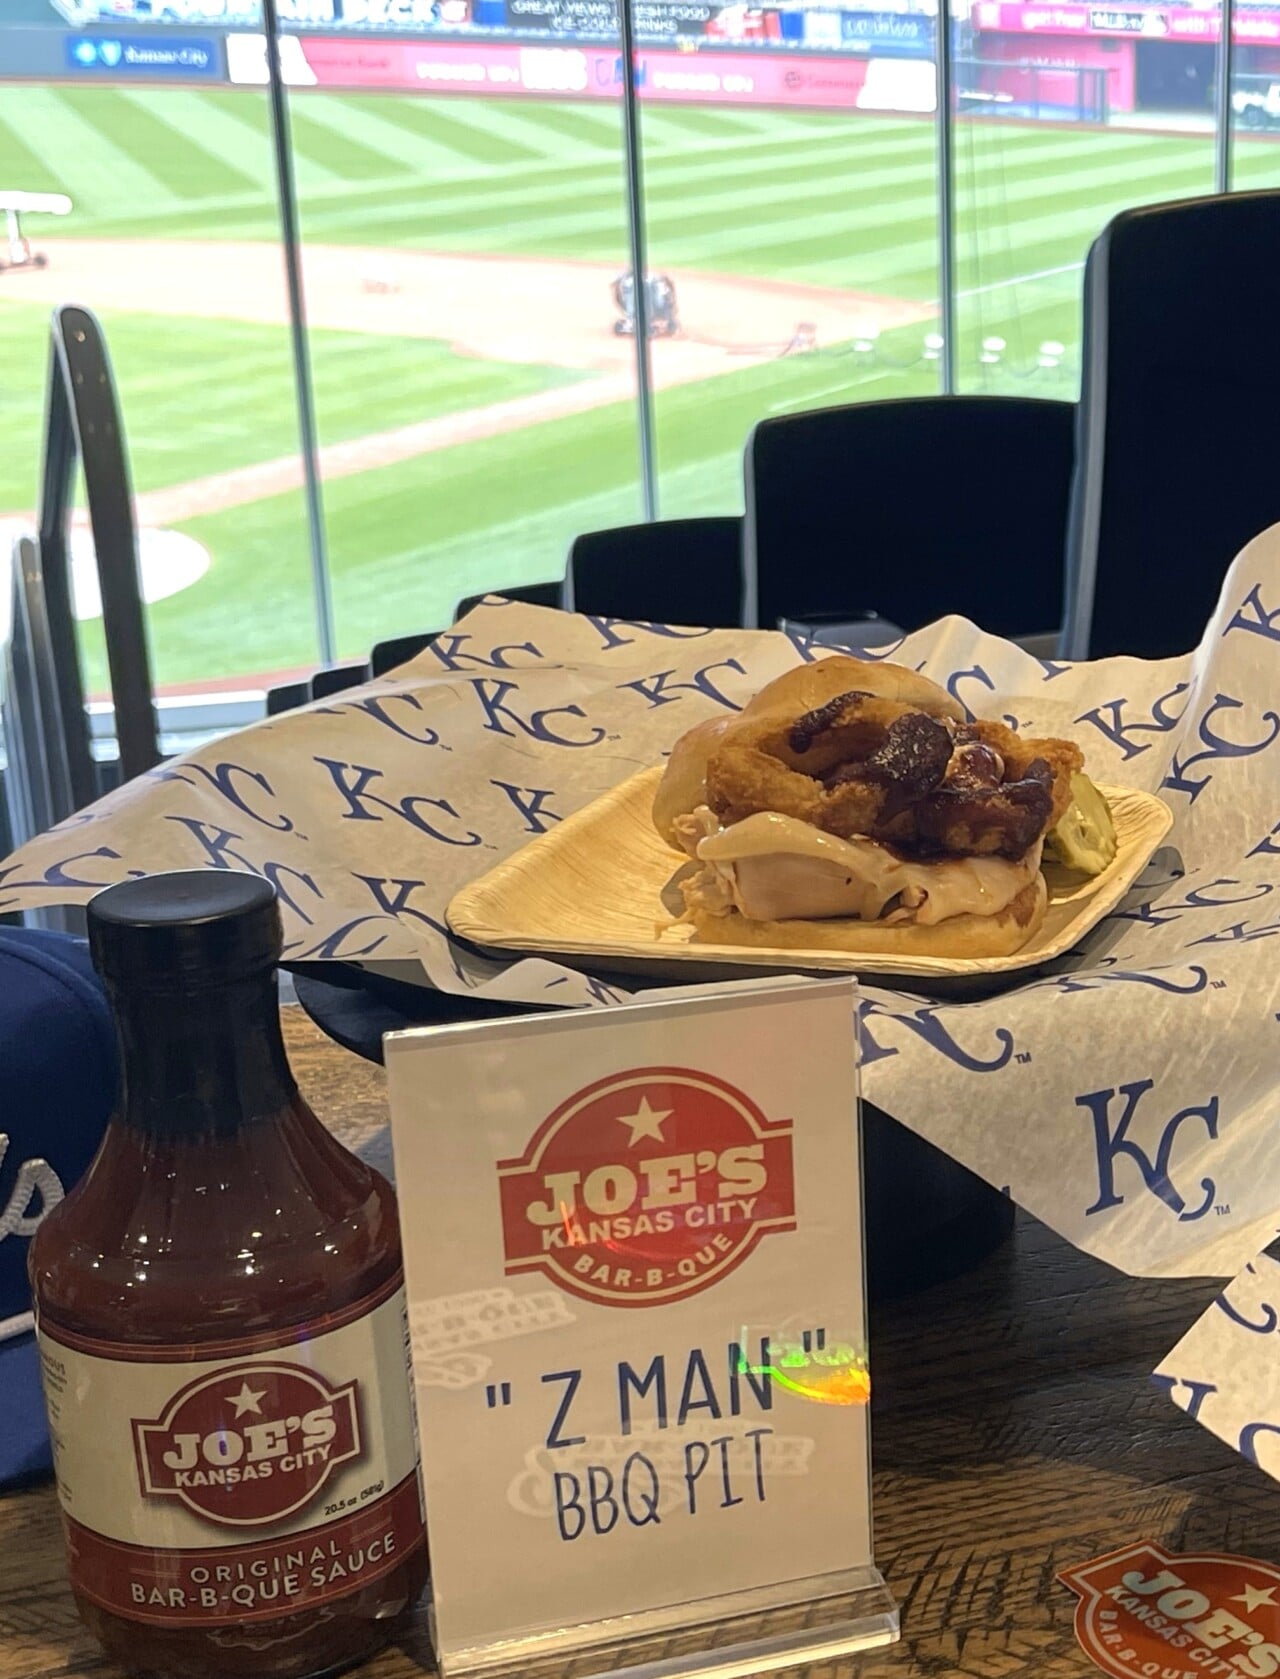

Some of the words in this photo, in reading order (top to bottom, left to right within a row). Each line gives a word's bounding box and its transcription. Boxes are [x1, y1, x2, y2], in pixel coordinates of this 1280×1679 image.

[472, 679, 606, 748] KC
[1073, 681, 1192, 762] KC
[313, 755, 483, 848] KC
[1075, 1078, 1220, 1223] KC
[526, 1143, 768, 1227] JOE'S
[541, 1210, 675, 1251] KANSAS
[684, 1197, 758, 1229] CITY
[572, 1232, 735, 1288] BAR-B-QUE
[163, 1404, 337, 1470] JOE'S
[174, 1461, 273, 1488] KANSAS
[279, 1443, 332, 1473] CITY
[323, 1499, 346, 1517] 20.5
[553, 1450, 661, 1541] BBQ
[684, 1428, 774, 1515] PIT
[130, 1573, 303, 1609] BAR-B-QUE
[309, 1531, 396, 1588] SAUCE
[190, 1539, 342, 1585] ORIGINAL
[1104, 1585, 1194, 1649] KANSAS
